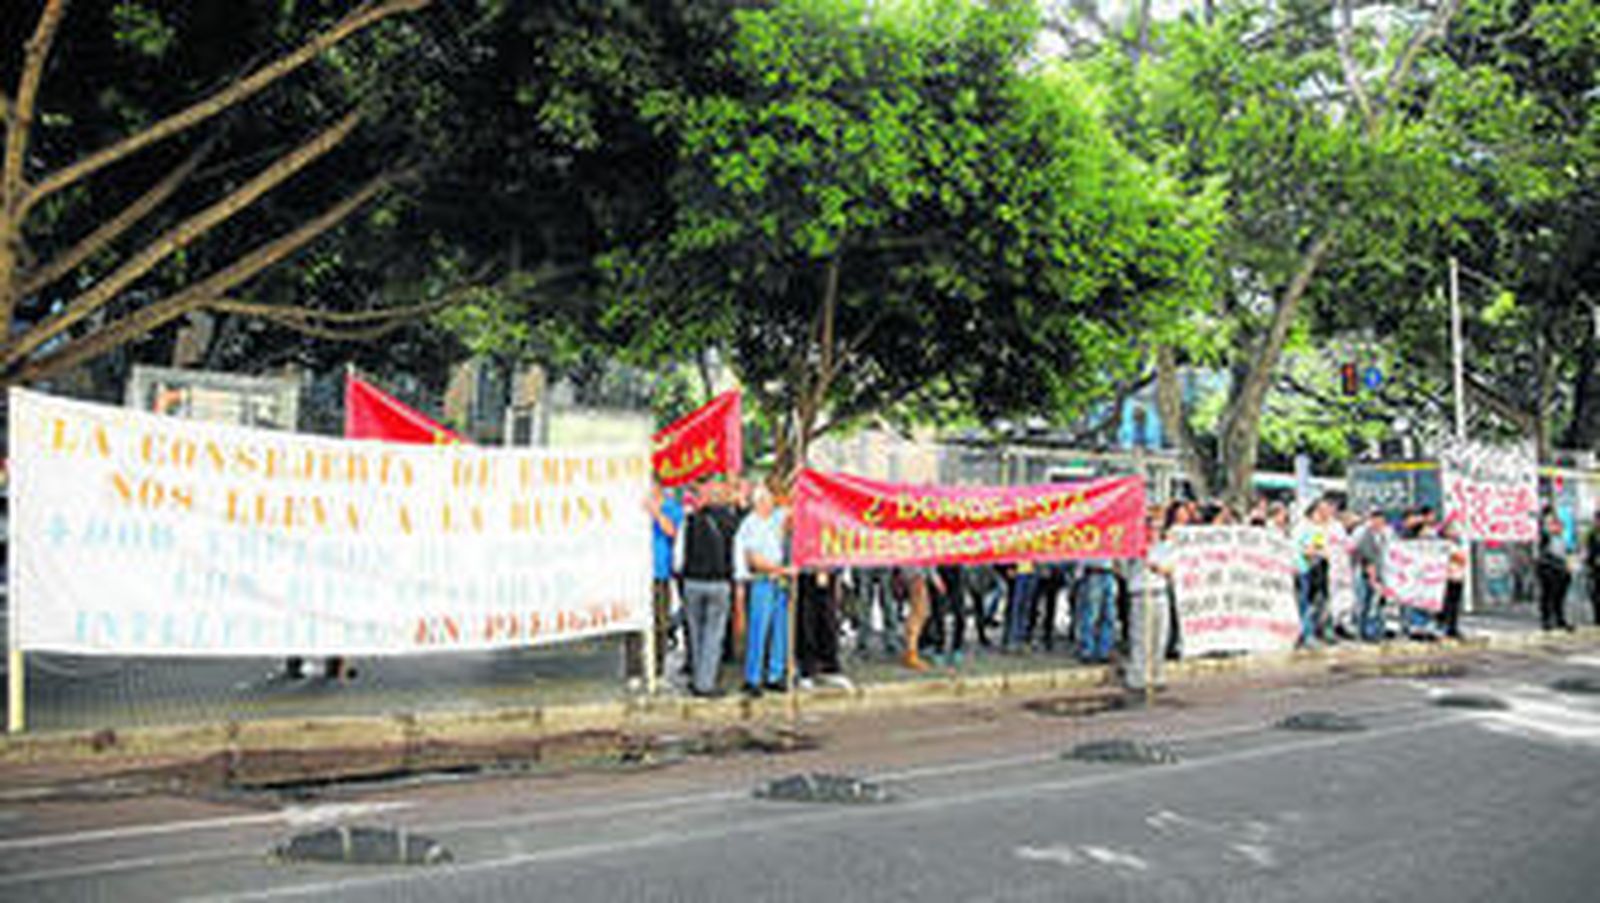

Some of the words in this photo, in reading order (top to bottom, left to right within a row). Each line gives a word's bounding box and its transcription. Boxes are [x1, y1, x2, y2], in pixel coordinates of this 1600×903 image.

[50, 417, 111, 460] LA
[110, 472, 195, 513] NOS
[819, 525, 984, 556] NUESTRO
